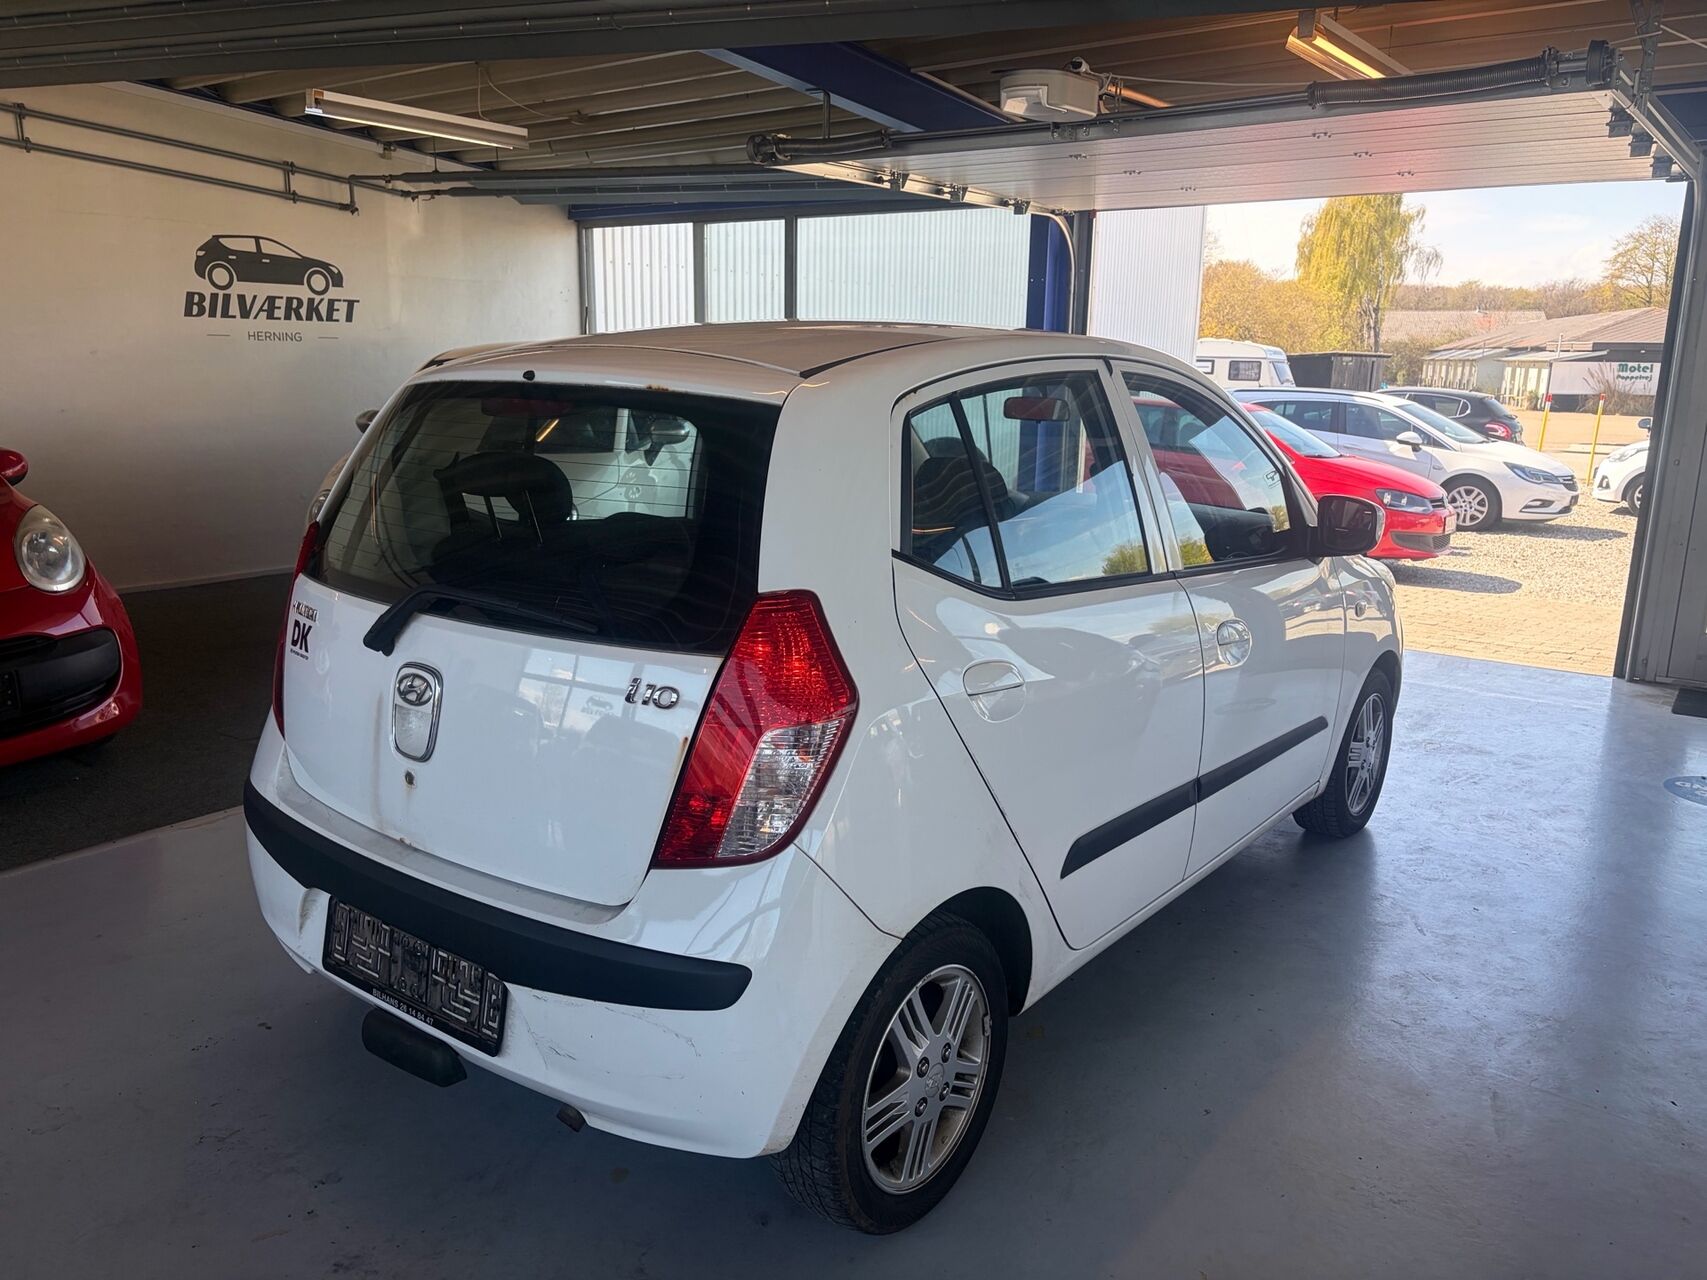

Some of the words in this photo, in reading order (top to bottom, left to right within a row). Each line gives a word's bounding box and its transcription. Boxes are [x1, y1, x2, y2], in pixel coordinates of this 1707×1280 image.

[184, 291, 360, 323] BILVÆRKET
[247, 331, 303, 342] HERNING
[1617, 363, 1654, 373] Motel
[291, 619, 312, 653] DK
[624, 677, 680, 710] i10
